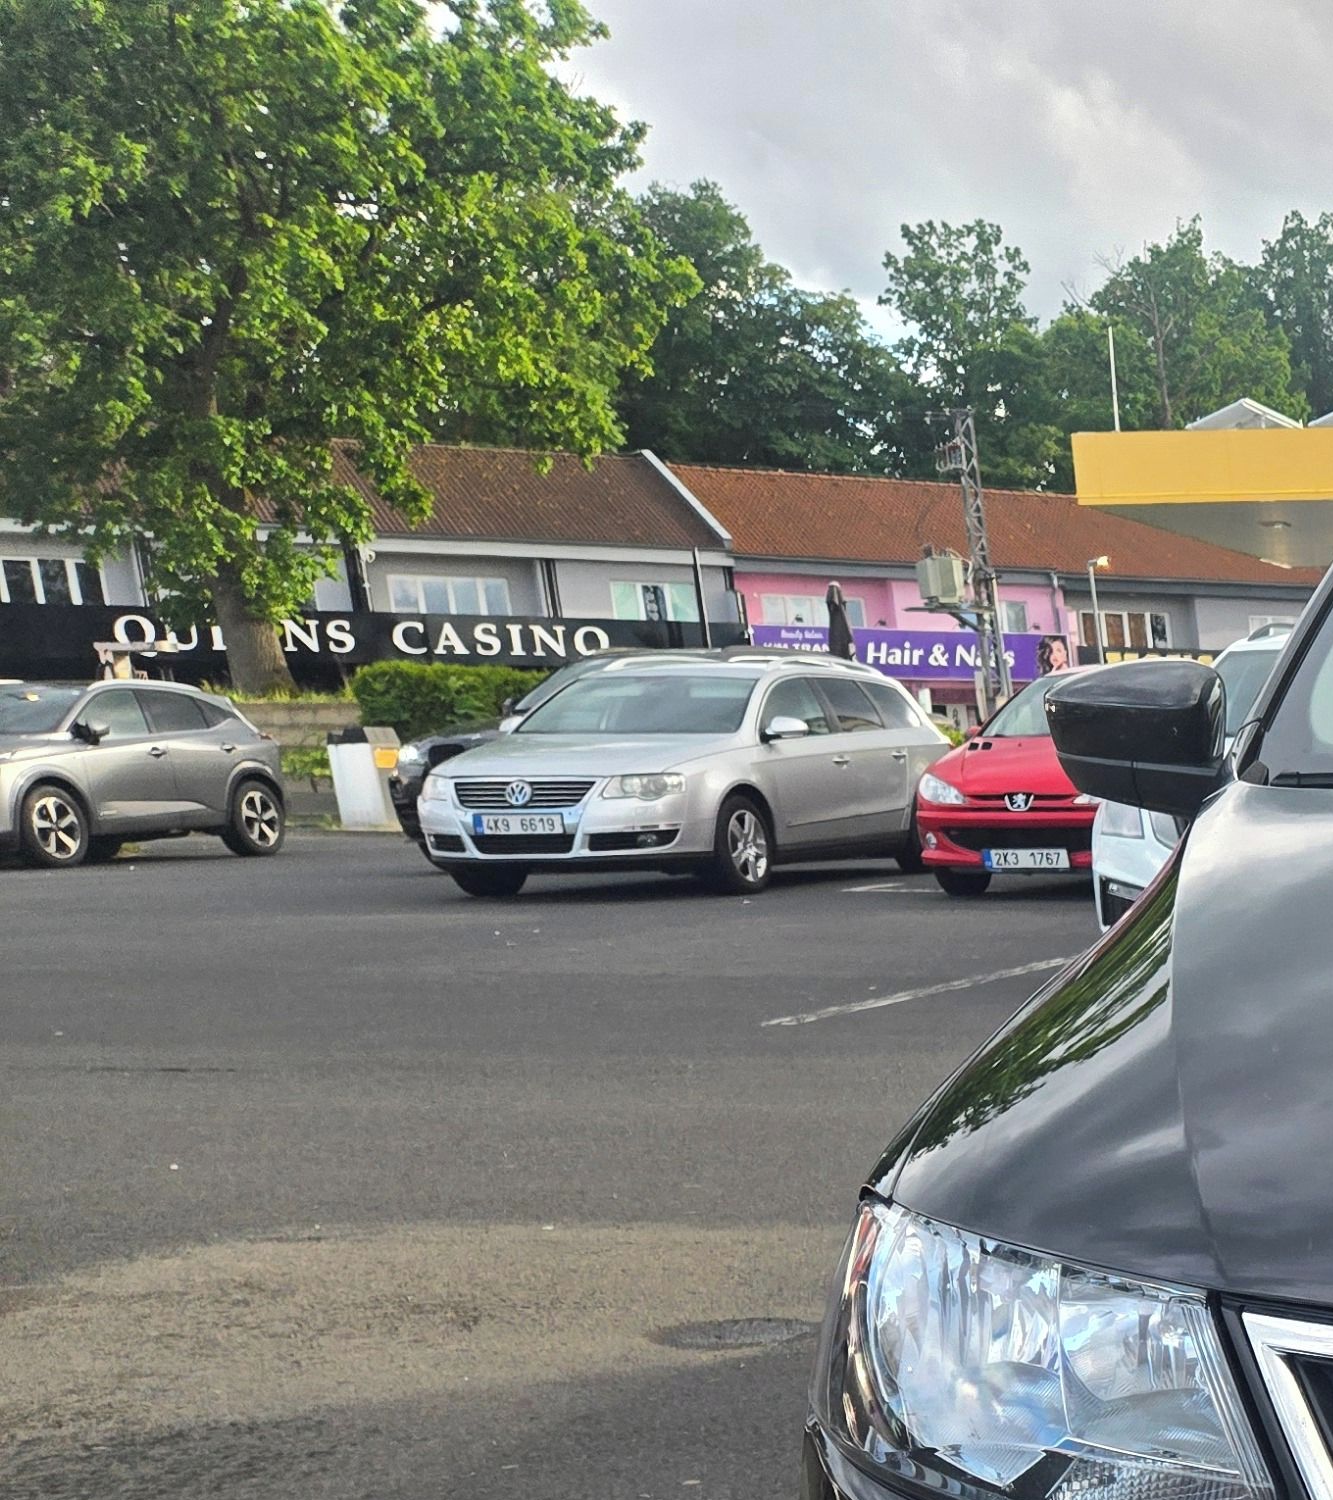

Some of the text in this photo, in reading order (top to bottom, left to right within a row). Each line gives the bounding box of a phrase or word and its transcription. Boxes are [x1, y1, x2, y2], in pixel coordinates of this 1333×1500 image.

[113, 614, 610, 657] QUNS CASINO
[866, 641, 924, 665] Hair
[928, 643, 949, 667] &
[520, 818, 555, 832] 6619
[994, 852, 1060, 866] 2K3 1767
